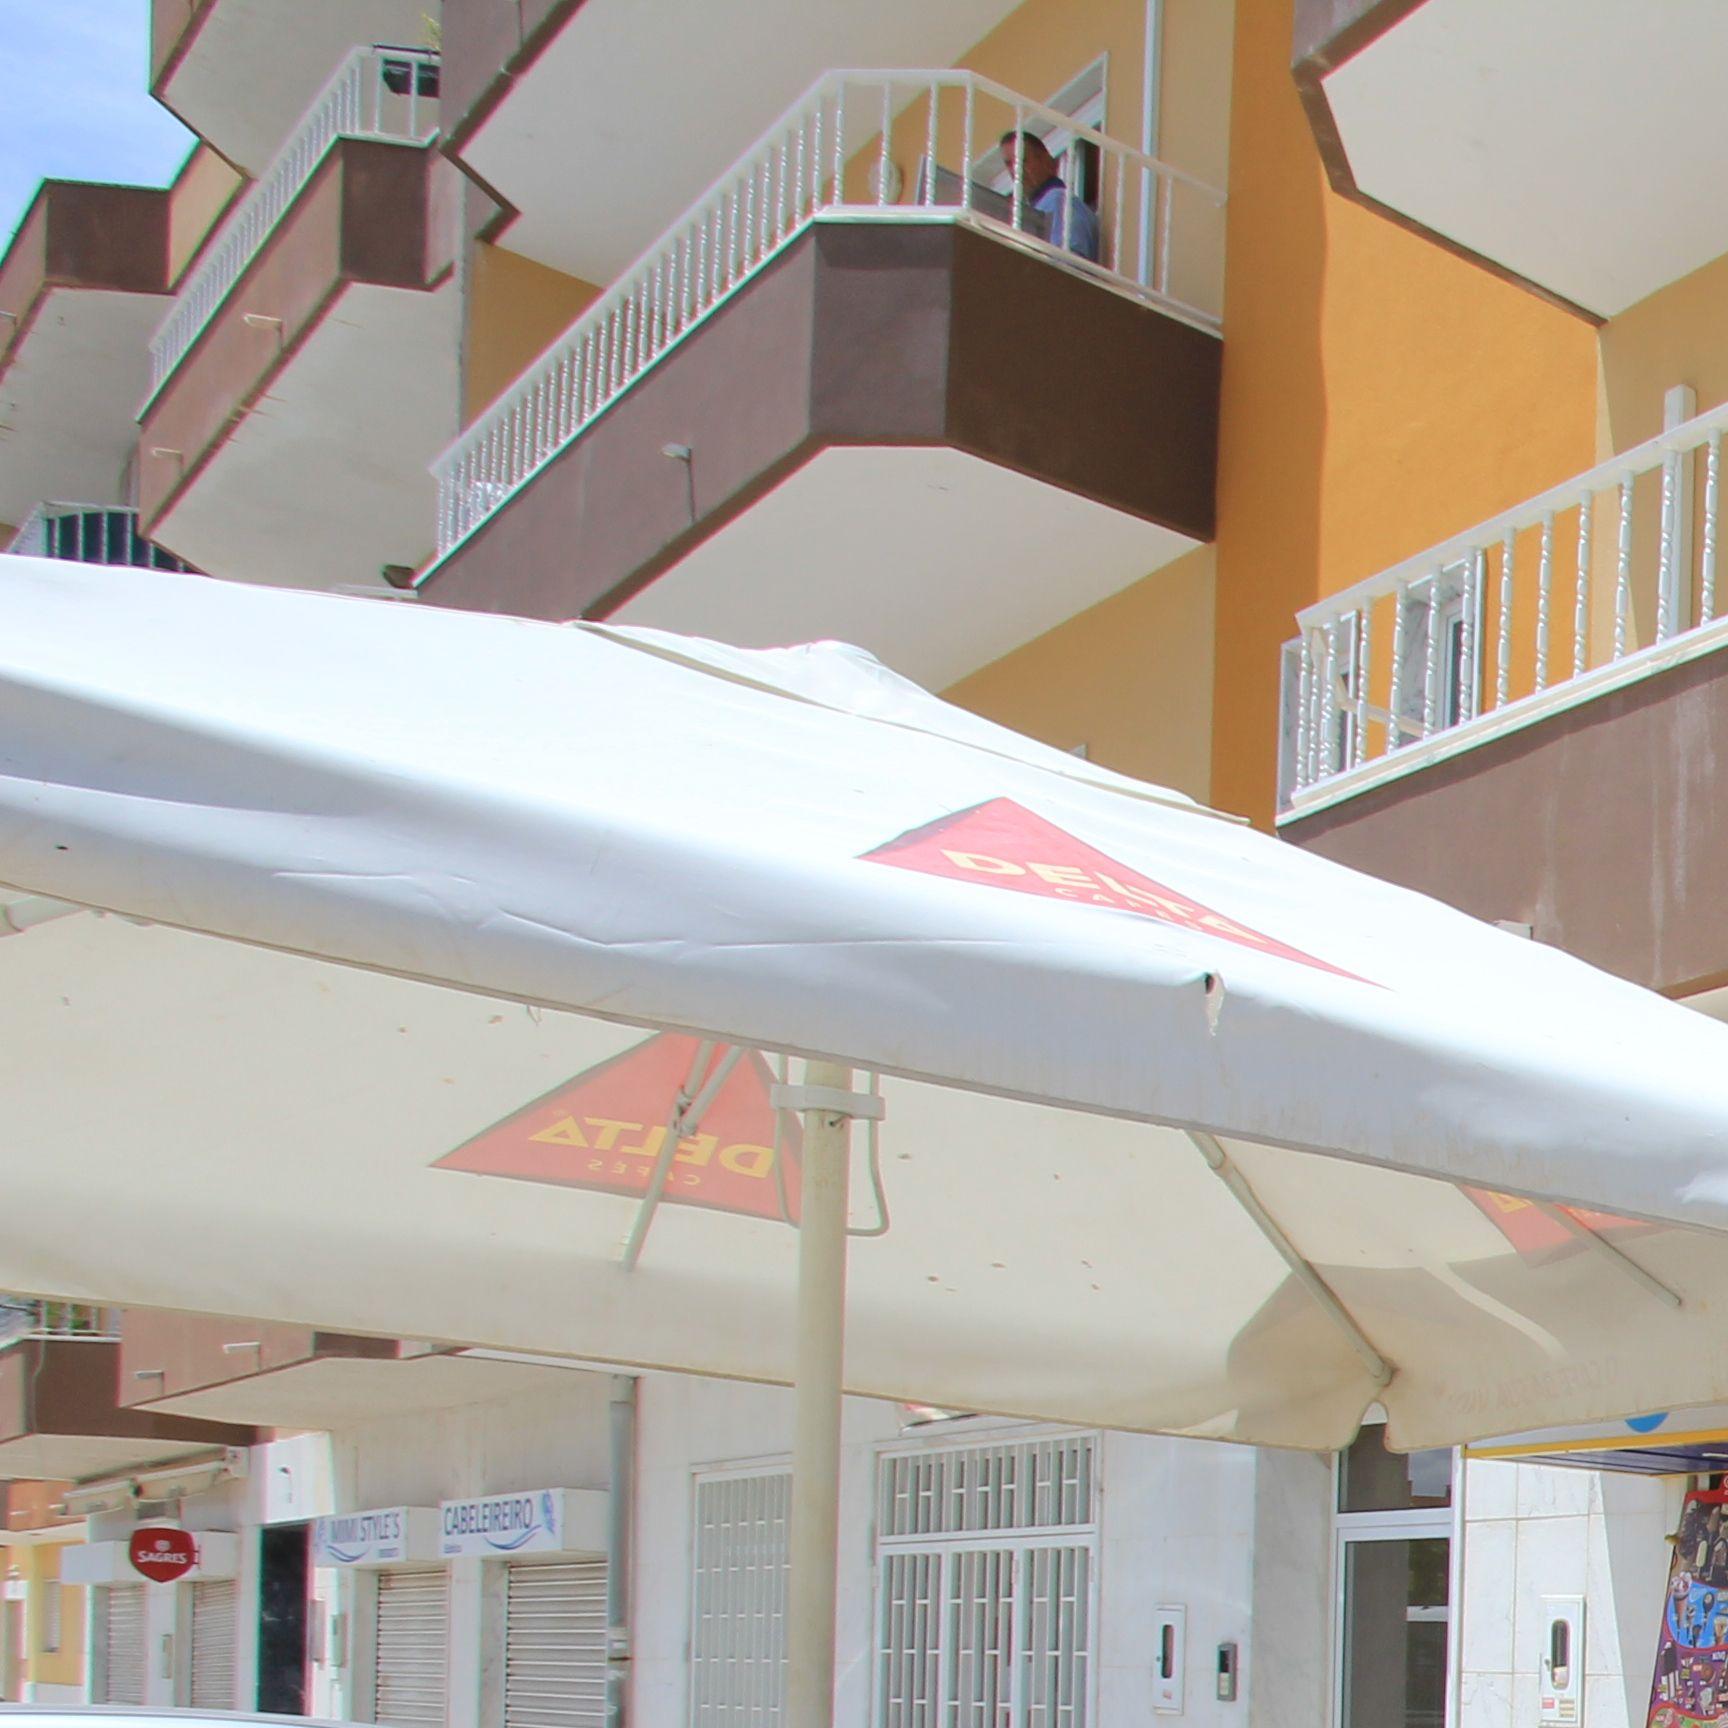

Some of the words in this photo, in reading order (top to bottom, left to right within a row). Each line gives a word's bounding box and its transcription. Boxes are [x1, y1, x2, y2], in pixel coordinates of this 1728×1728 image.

[941, 848, 1268, 945] DELTA
[443, 1497, 534, 1536] CABELEIREIRO
[137, 1550, 188, 1565] SAGRES
